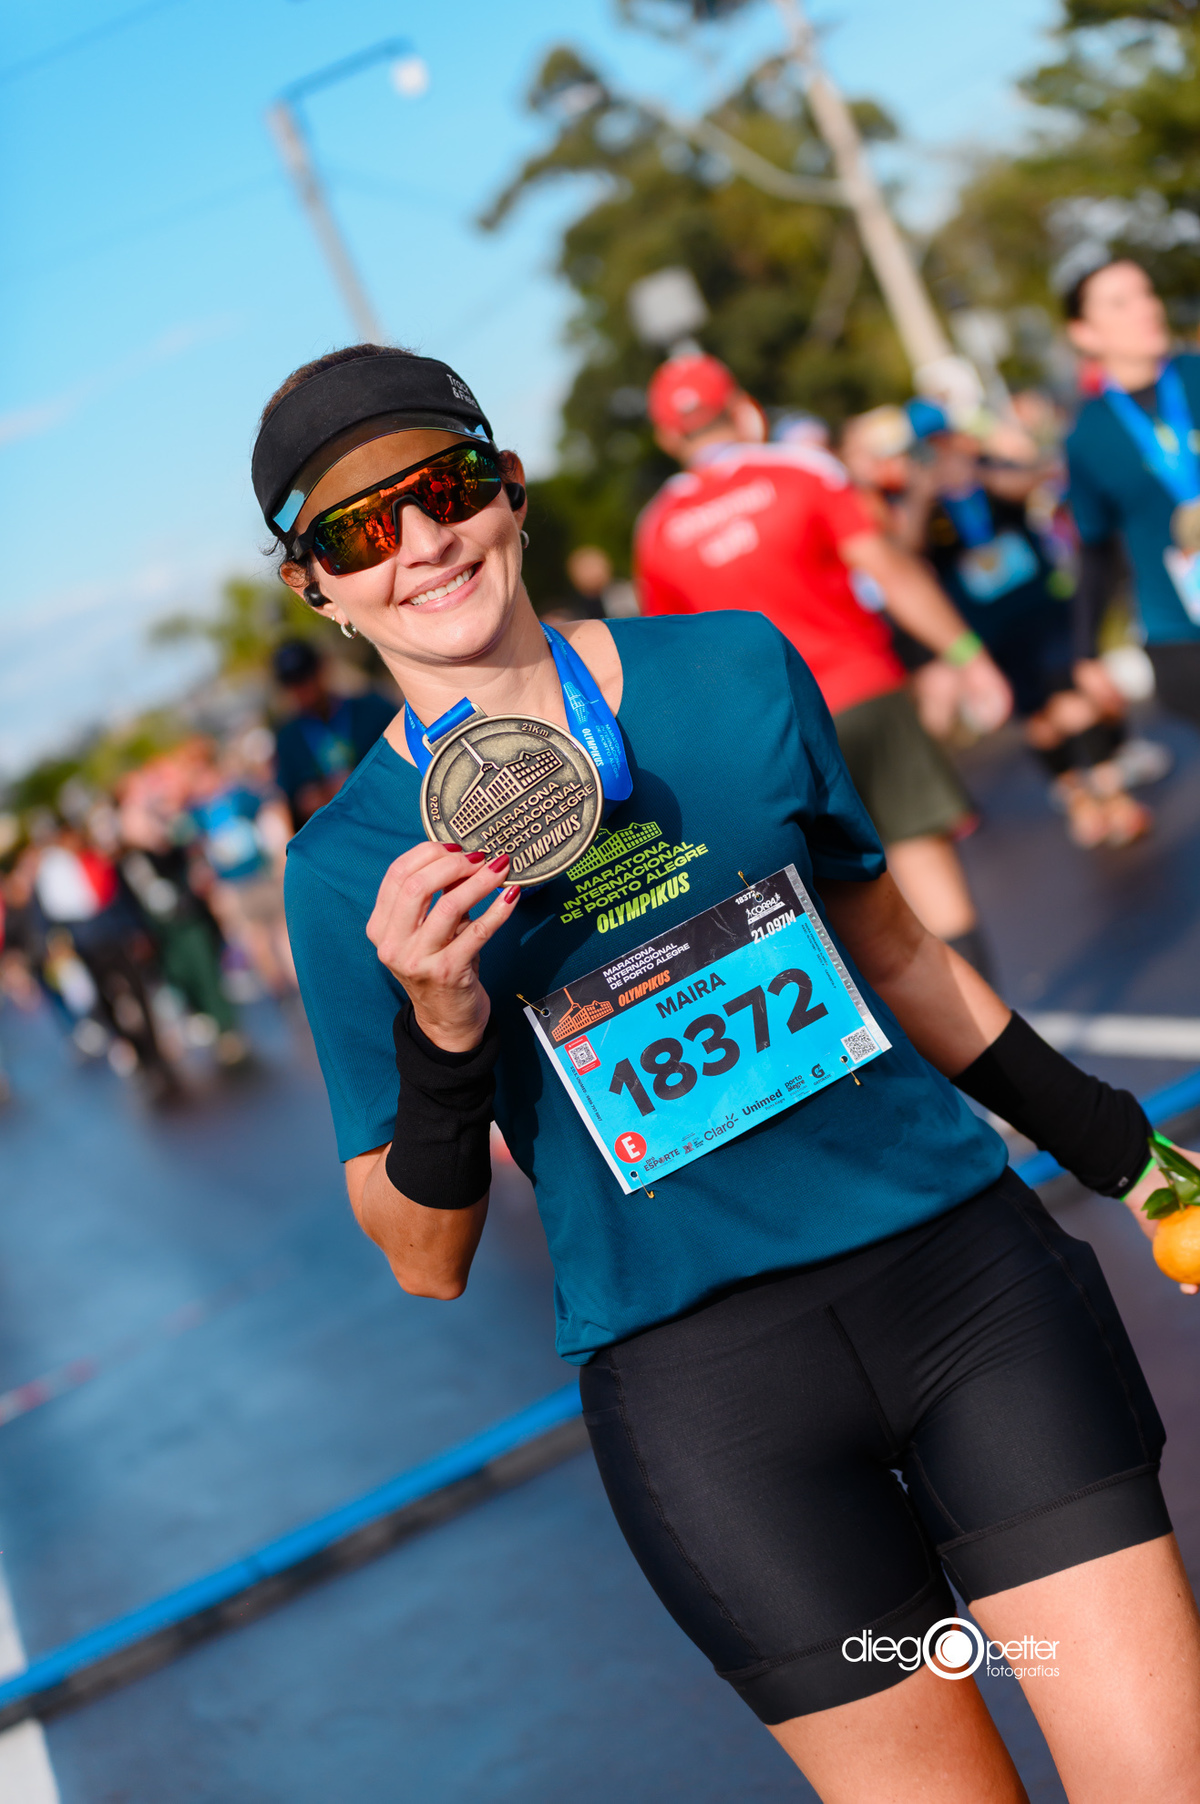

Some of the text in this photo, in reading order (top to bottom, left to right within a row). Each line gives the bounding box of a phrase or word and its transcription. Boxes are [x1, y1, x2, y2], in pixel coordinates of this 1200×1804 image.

[521, 723, 549, 738] 21Km
[582, 728, 605, 767] OLYMPIKUS
[430, 796, 440, 821] 2026
[478, 781, 582, 854] NTERNACIONAL
[481, 782, 560, 839] MARATONA
[545, 783, 596, 825] ALEGRE
[512, 814, 581, 873] OLYMPIKUS
[560, 843, 709, 924] DE PORTO ALEGRE
[563, 841, 694, 911] INTERNACIONAL
[575, 841, 670, 893] MARATONA
[597, 872, 691, 934] OLYMPIKUS
[751, 898, 777, 916] CORPA
[751, 909, 797, 944] 21.097M
[602, 946, 655, 978] MARATONA
[606, 943, 678, 984] INTERNACIONAL
[609, 942, 691, 990] DE PORTO ALEGRE
[618, 969, 671, 1007] OLYMPIKUS
[655, 972, 727, 1019] MAIRA
[608, 968, 829, 1117] 18372
[742, 1088, 783, 1116] Unimed
[784, 1074, 803, 1089] porto
[621, 1136, 641, 1159] E
[703, 1118, 736, 1141] Claro
